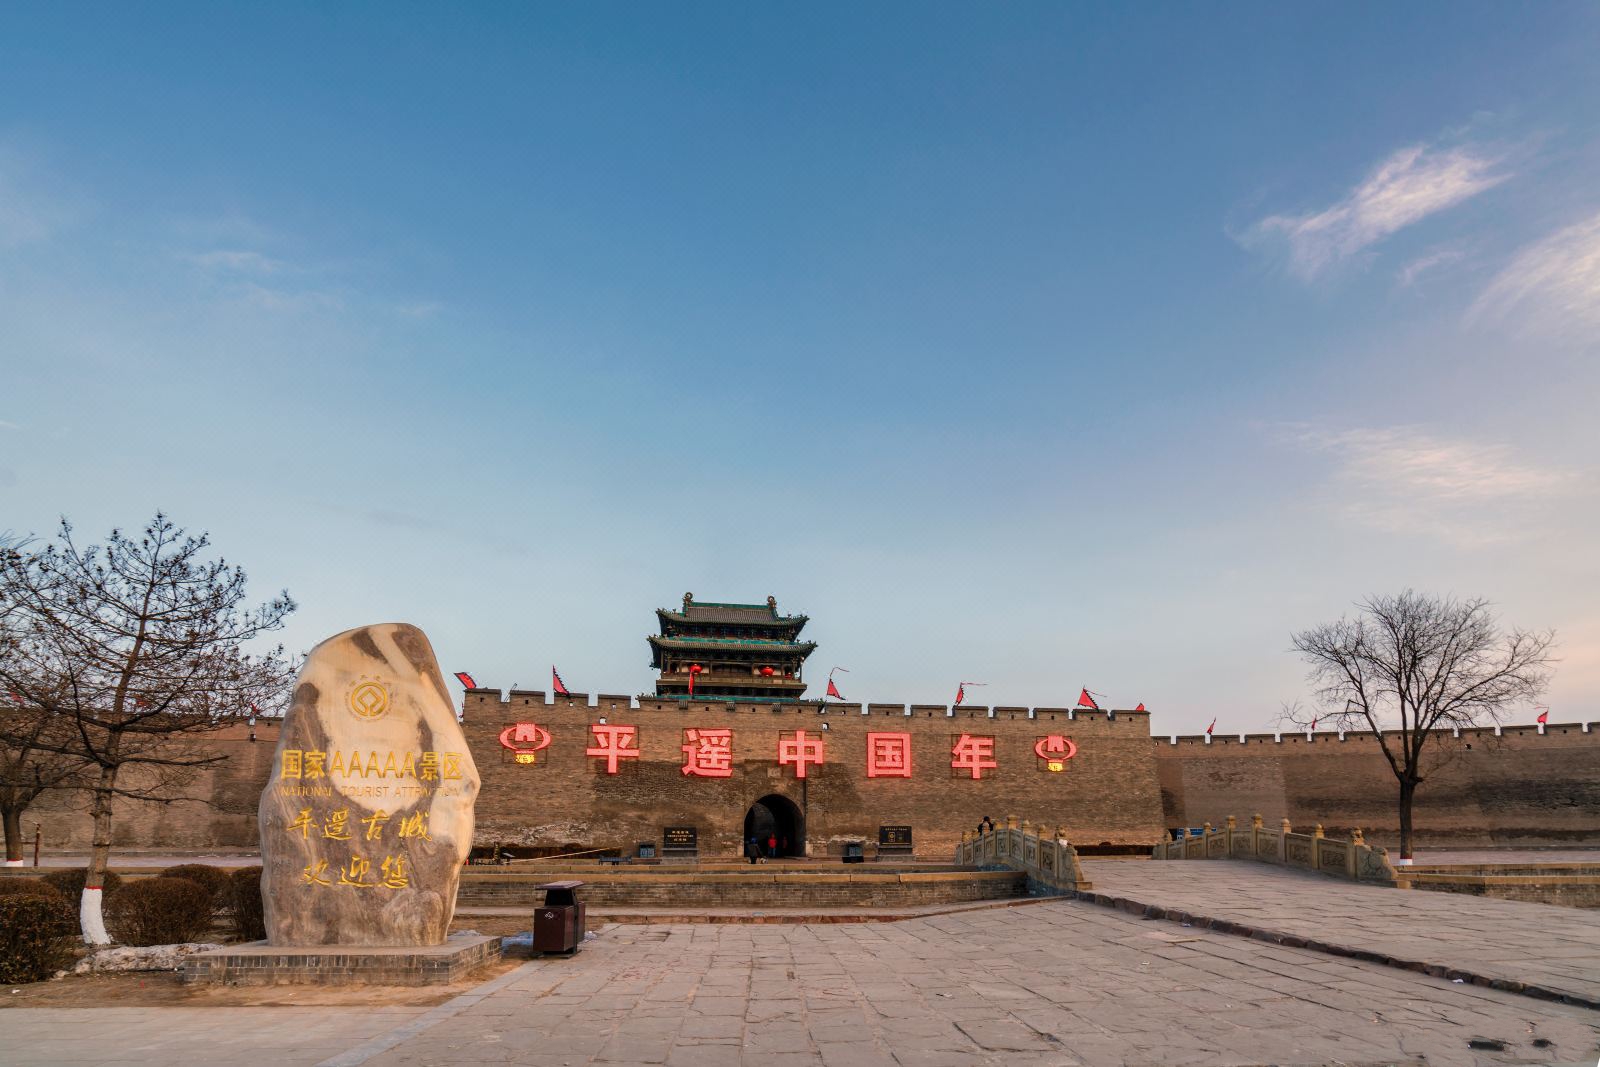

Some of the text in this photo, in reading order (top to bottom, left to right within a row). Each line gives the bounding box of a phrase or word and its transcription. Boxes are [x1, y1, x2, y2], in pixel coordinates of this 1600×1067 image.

[281, 748, 463, 780] 国家AAAAA景区
[586, 723, 998, 780] 平遥中国年
[281, 786, 462, 798] NATIONAL TOURIST ATTRATN
